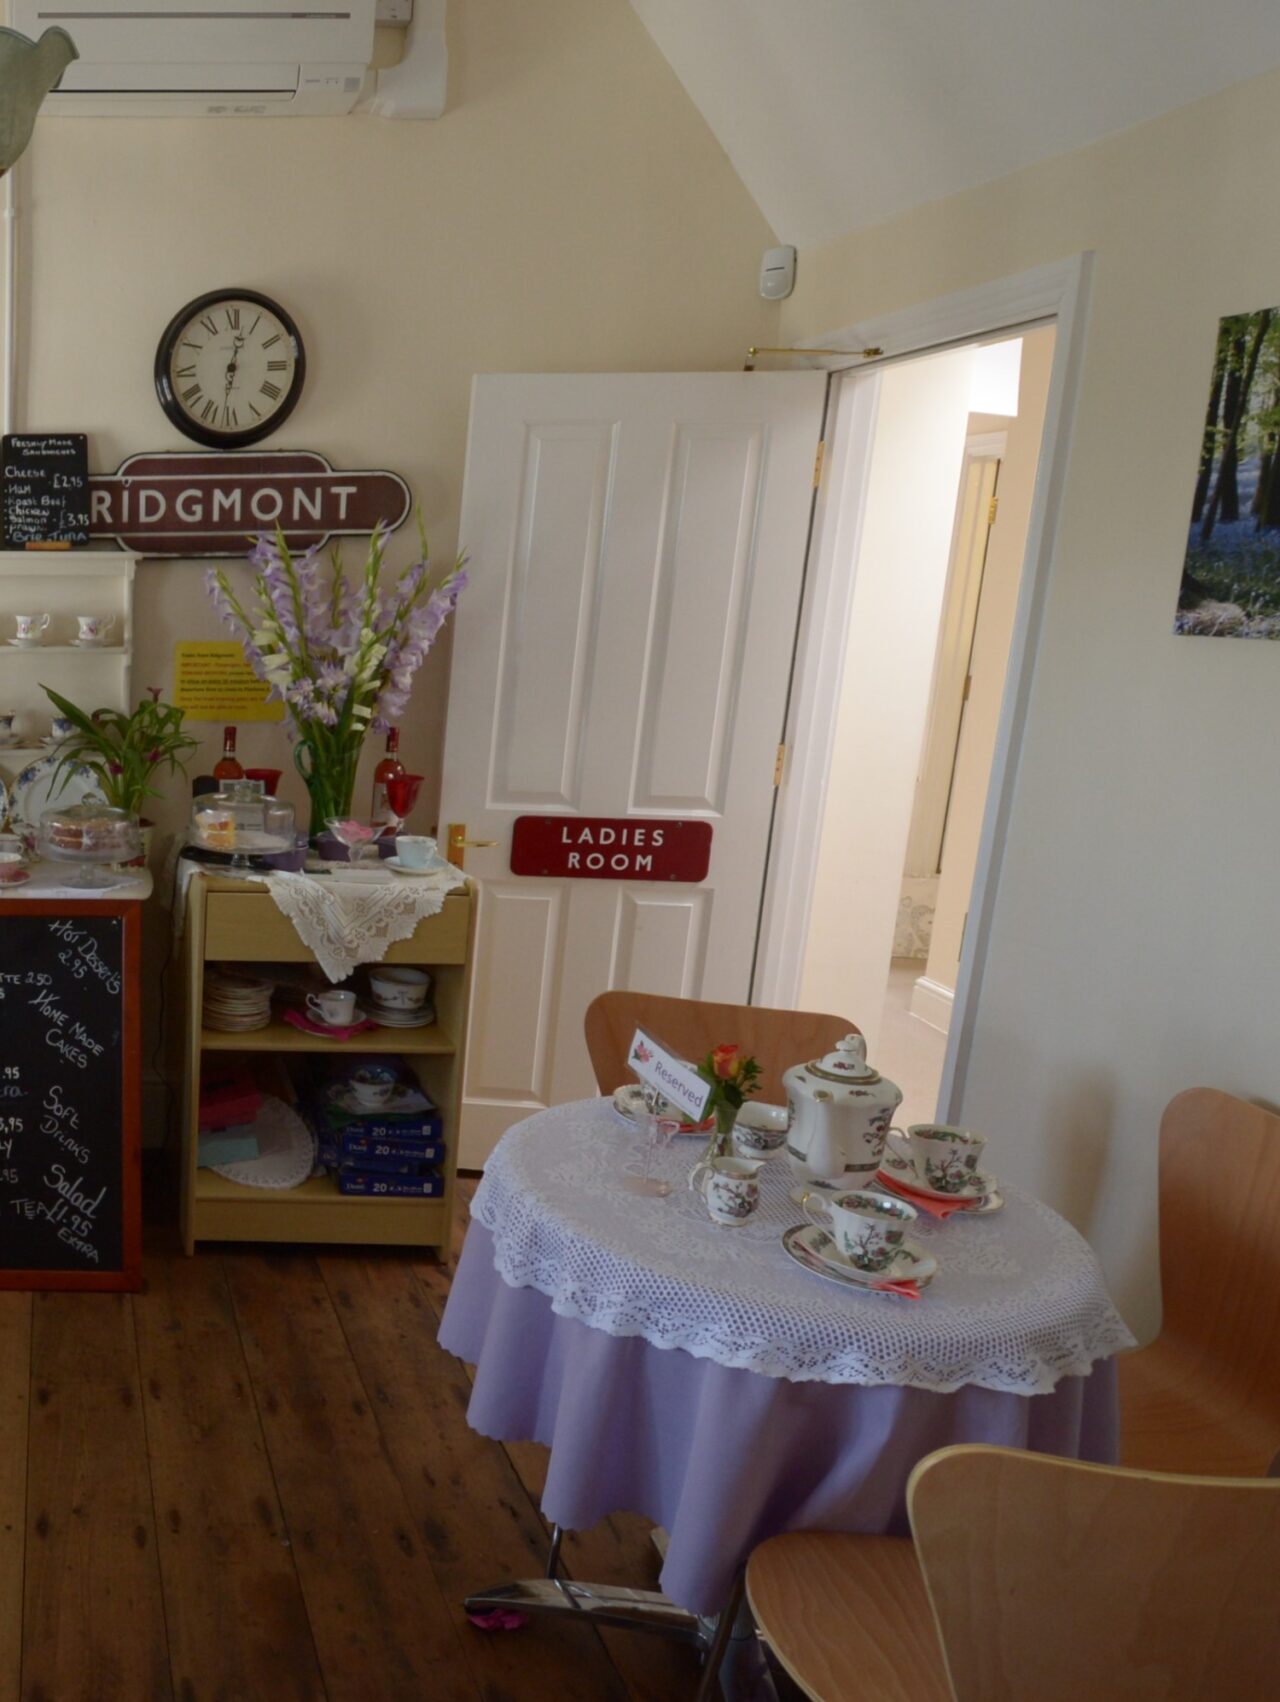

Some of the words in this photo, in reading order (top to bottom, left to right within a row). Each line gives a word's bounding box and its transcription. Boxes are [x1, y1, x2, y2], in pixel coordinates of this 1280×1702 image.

[91, 486, 358, 523] RIDGMONT
[561, 826, 665, 847] LADIES
[567, 852, 654, 872] ROOM
[58, 948, 88, 979] 2.95
[27, 988, 70, 1028] HOME
[68, 1021, 105, 1057] MADE
[45, 1028, 88, 1069] CAKES
[654, 1060, 705, 1108] Reserved
[42, 1085, 80, 1130] Soft
[371, 1127, 387, 1136] 20
[375, 1145, 390, 1155] 20
[43, 1163, 108, 1220] Salad
[372, 1183, 388, 1192] 20
[10, 1198, 49, 1216] TEA
[56, 1226, 100, 1265] EXTRA
